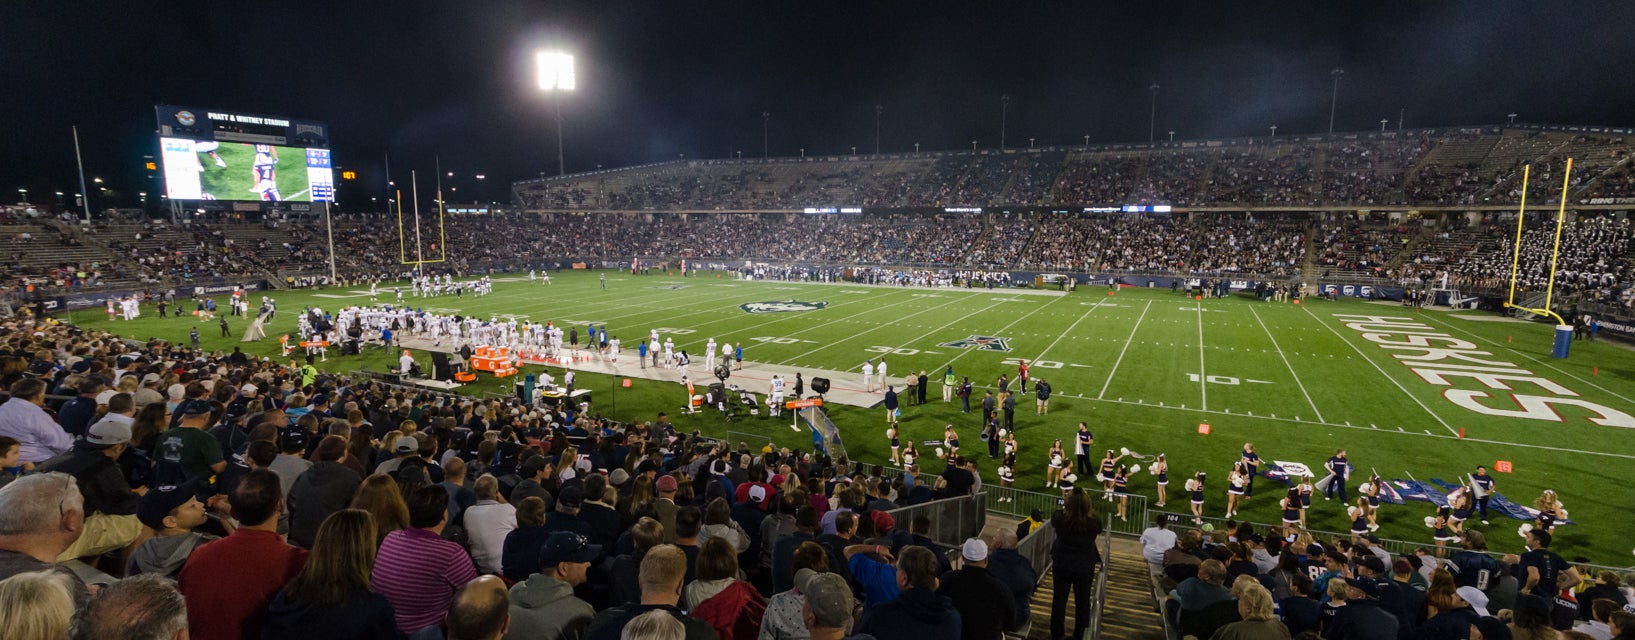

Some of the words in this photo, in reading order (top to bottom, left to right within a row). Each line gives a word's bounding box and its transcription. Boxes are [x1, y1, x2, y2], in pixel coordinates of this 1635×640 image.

[208, 112, 229, 120] PRATT
[236, 115, 263, 124] WHITNEY
[264, 118, 290, 127] STADIUM
[1185, 373, 1240, 385] 10
[1556, 599, 1577, 611] UCONN
